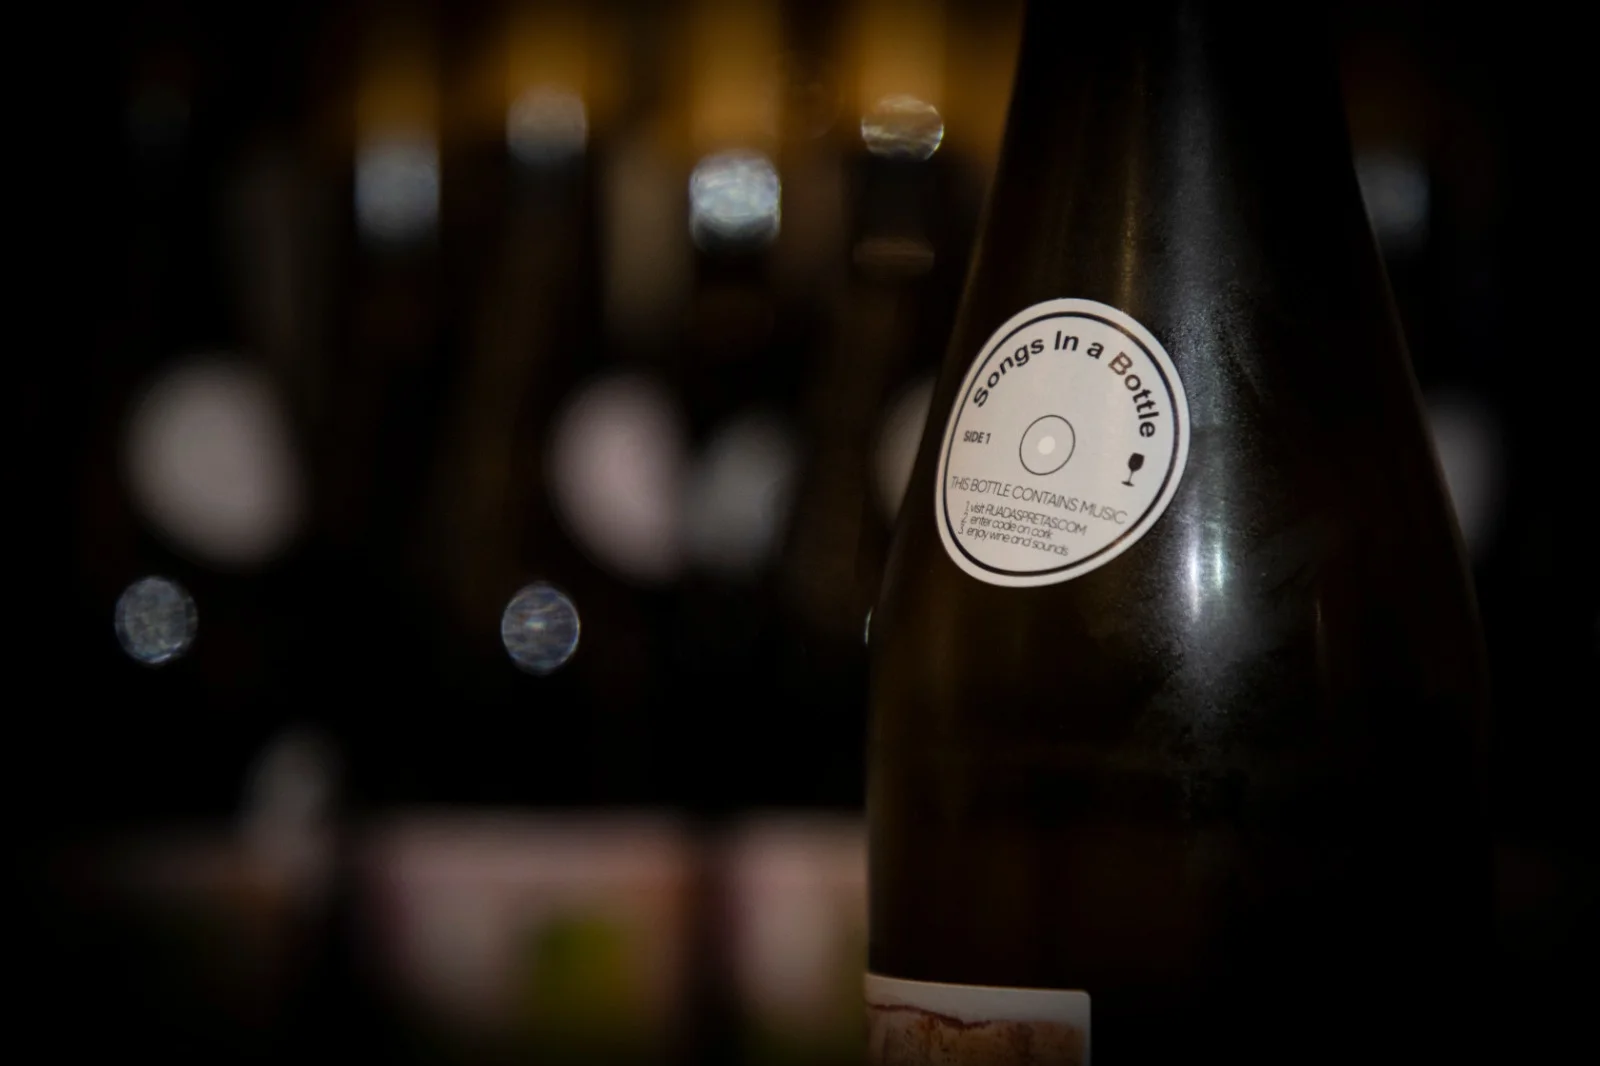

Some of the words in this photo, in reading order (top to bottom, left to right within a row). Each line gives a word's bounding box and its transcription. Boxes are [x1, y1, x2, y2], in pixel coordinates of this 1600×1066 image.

[973, 338, 1045, 408] Songs
[1054, 330, 1079, 352] In
[1087, 341, 1104, 360] a
[1108, 351, 1160, 438] Bottle
[963, 430, 984, 444] SIDE
[985, 432, 991, 445] 1
[951, 476, 970, 490] THIS
[970, 478, 1011, 497] BOTTLE
[1012, 485, 1078, 513] CONTAINS
[1078, 501, 1128, 525] MUSIC
[970, 502, 985, 513] visit
[970, 515, 991, 527] enter
[992, 517, 1016, 531] code
[1017, 526, 1030, 534] on
[1031, 527, 1053, 539] cork
[967, 526, 990, 541] enjoy
[989, 530, 1010, 543] wine
[1011, 533, 1031, 547] and
[1033, 540, 1069, 557] sounds
